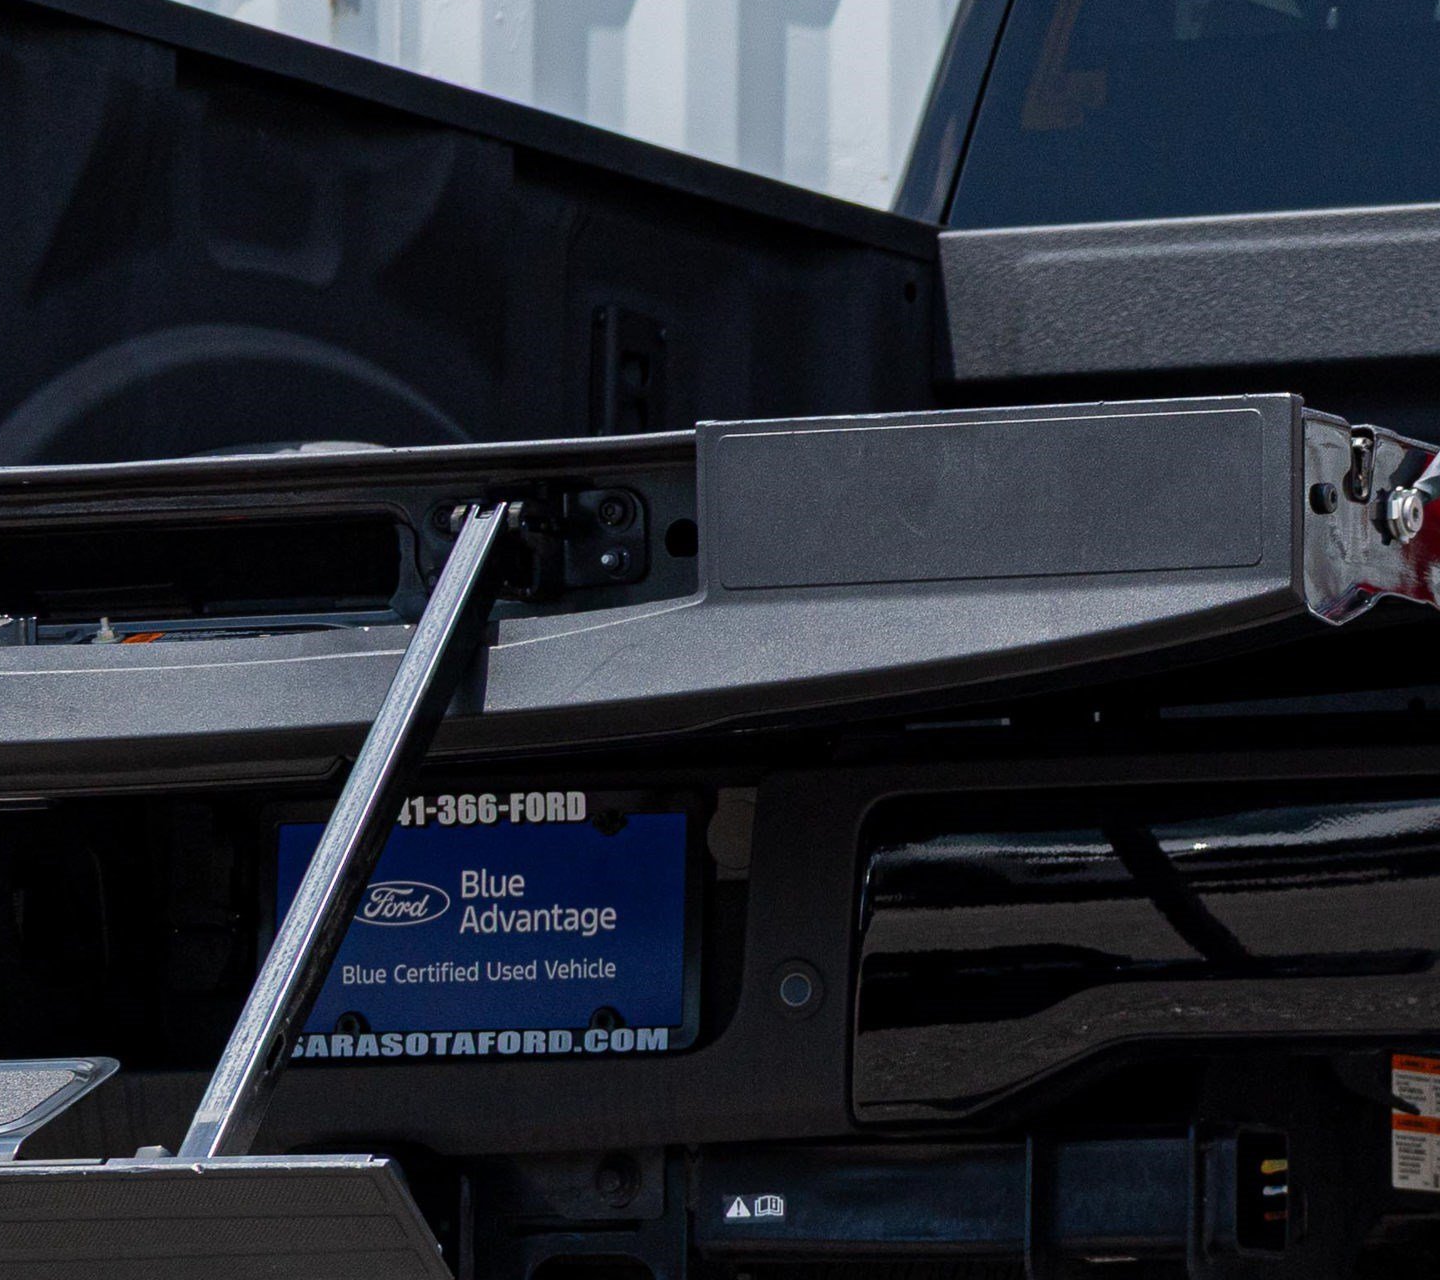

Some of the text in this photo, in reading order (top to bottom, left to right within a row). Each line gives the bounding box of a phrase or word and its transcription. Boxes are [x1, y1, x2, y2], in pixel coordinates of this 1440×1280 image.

[460, 869, 525, 899] Blue
[363, 887, 430, 919] Ford
[459, 904, 617, 937] Advantage
[342, 959, 617, 985] Blue Certified Used Vehicle
